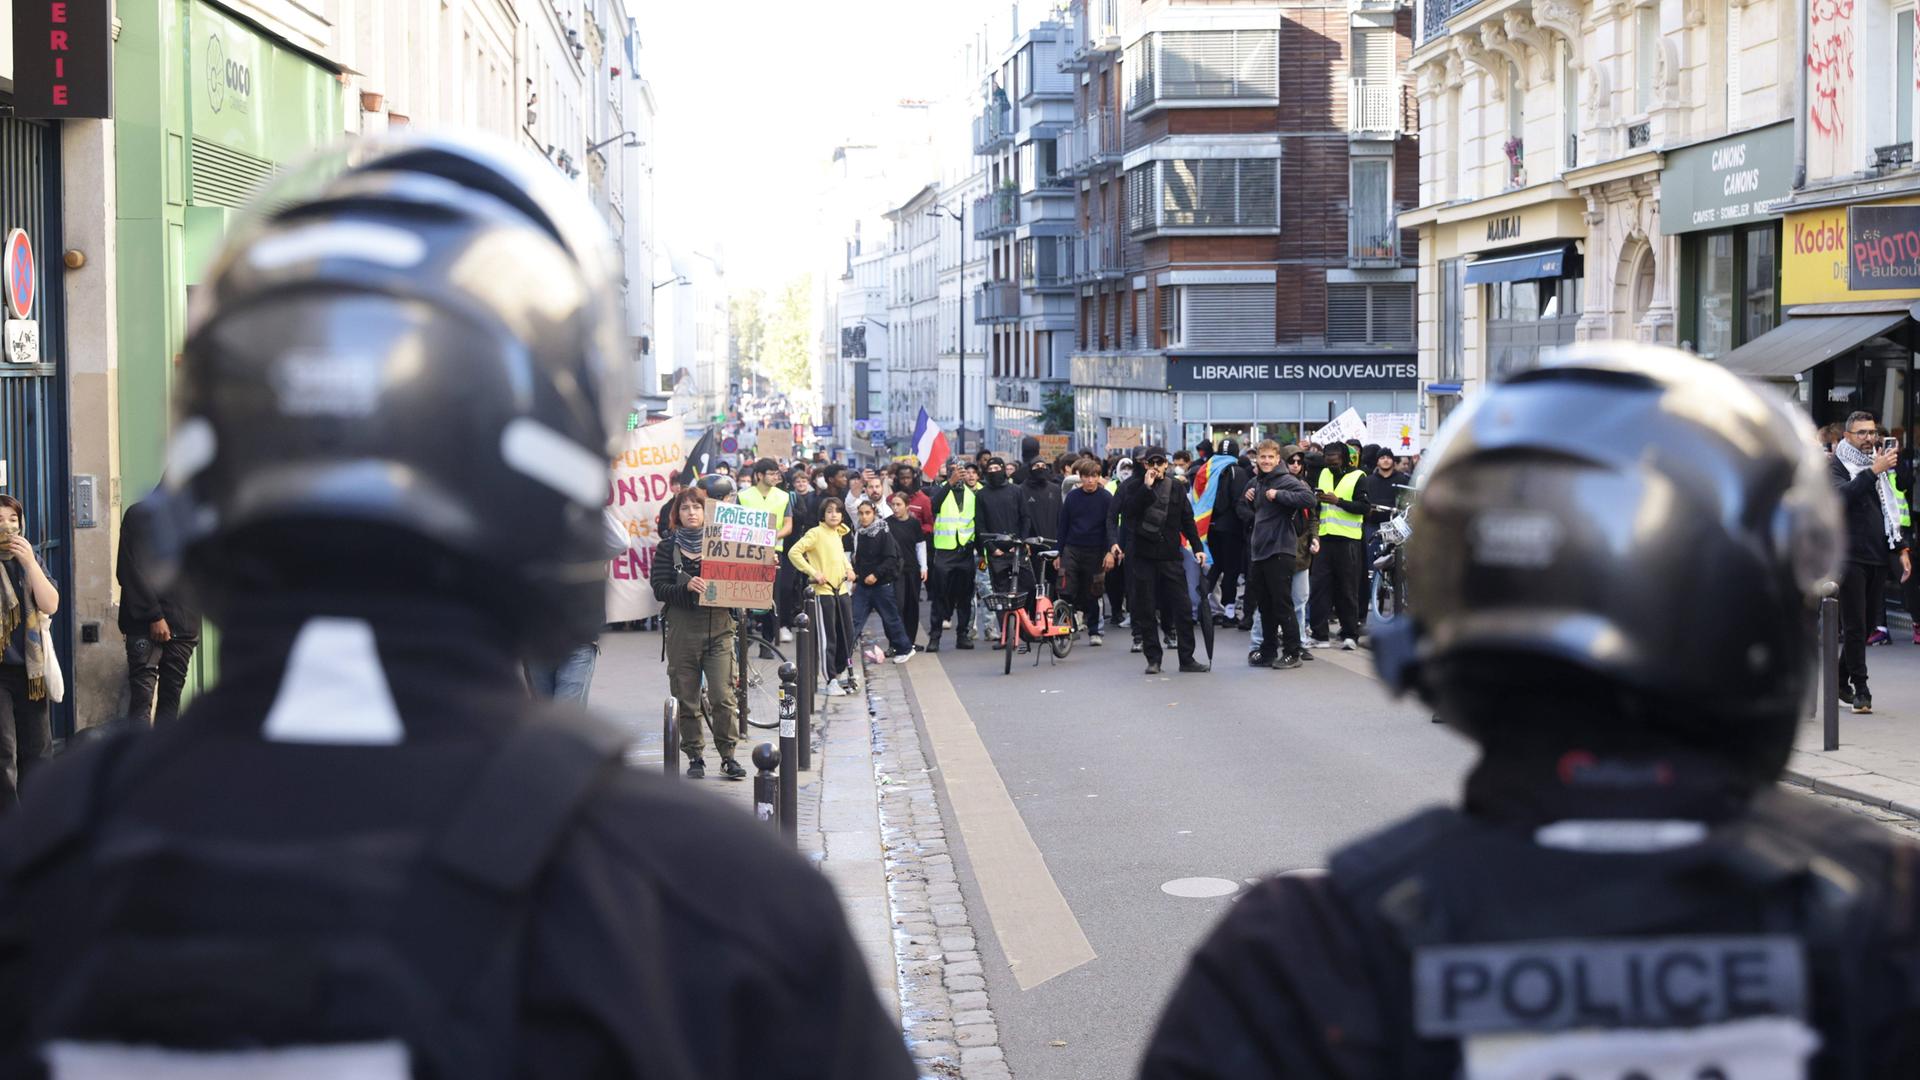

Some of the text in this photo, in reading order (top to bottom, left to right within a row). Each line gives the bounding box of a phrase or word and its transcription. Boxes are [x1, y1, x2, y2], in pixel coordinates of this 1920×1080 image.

[226, 58, 250, 97] COCO
[1711, 143, 1746, 172] CANONS
[1723, 168, 1759, 196] CANONS
[1794, 218, 1845, 255] Kodak
[1833, 261, 1850, 284] Dig
[1192, 364, 1417, 380] LIBRAIRIE LES NOUVEAUTES
[706, 540, 730, 558] PAS
[1440, 952, 1775, 1024] POLICE
